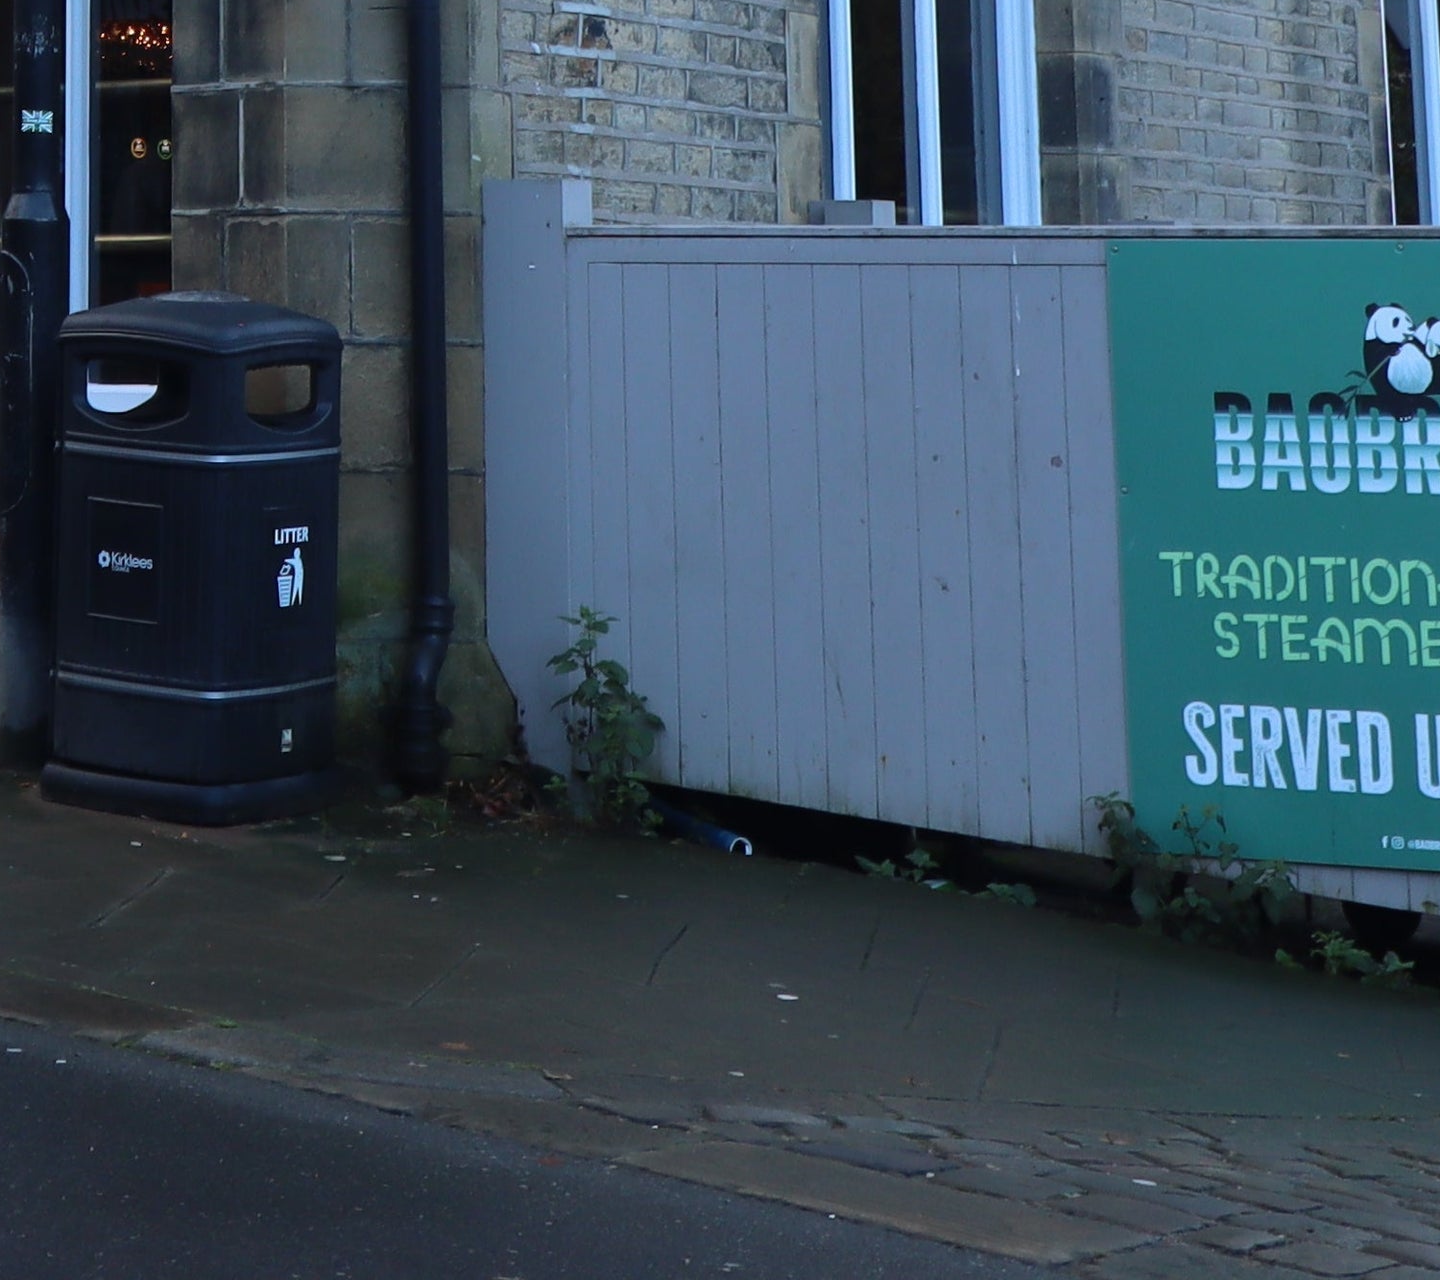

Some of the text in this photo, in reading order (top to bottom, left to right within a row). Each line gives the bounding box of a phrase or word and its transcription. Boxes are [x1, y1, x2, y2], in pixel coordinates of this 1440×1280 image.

[274, 526, 309, 545] LITTER
[111, 551, 153, 570] Kirklees
[1182, 700, 1394, 796] SERVED
